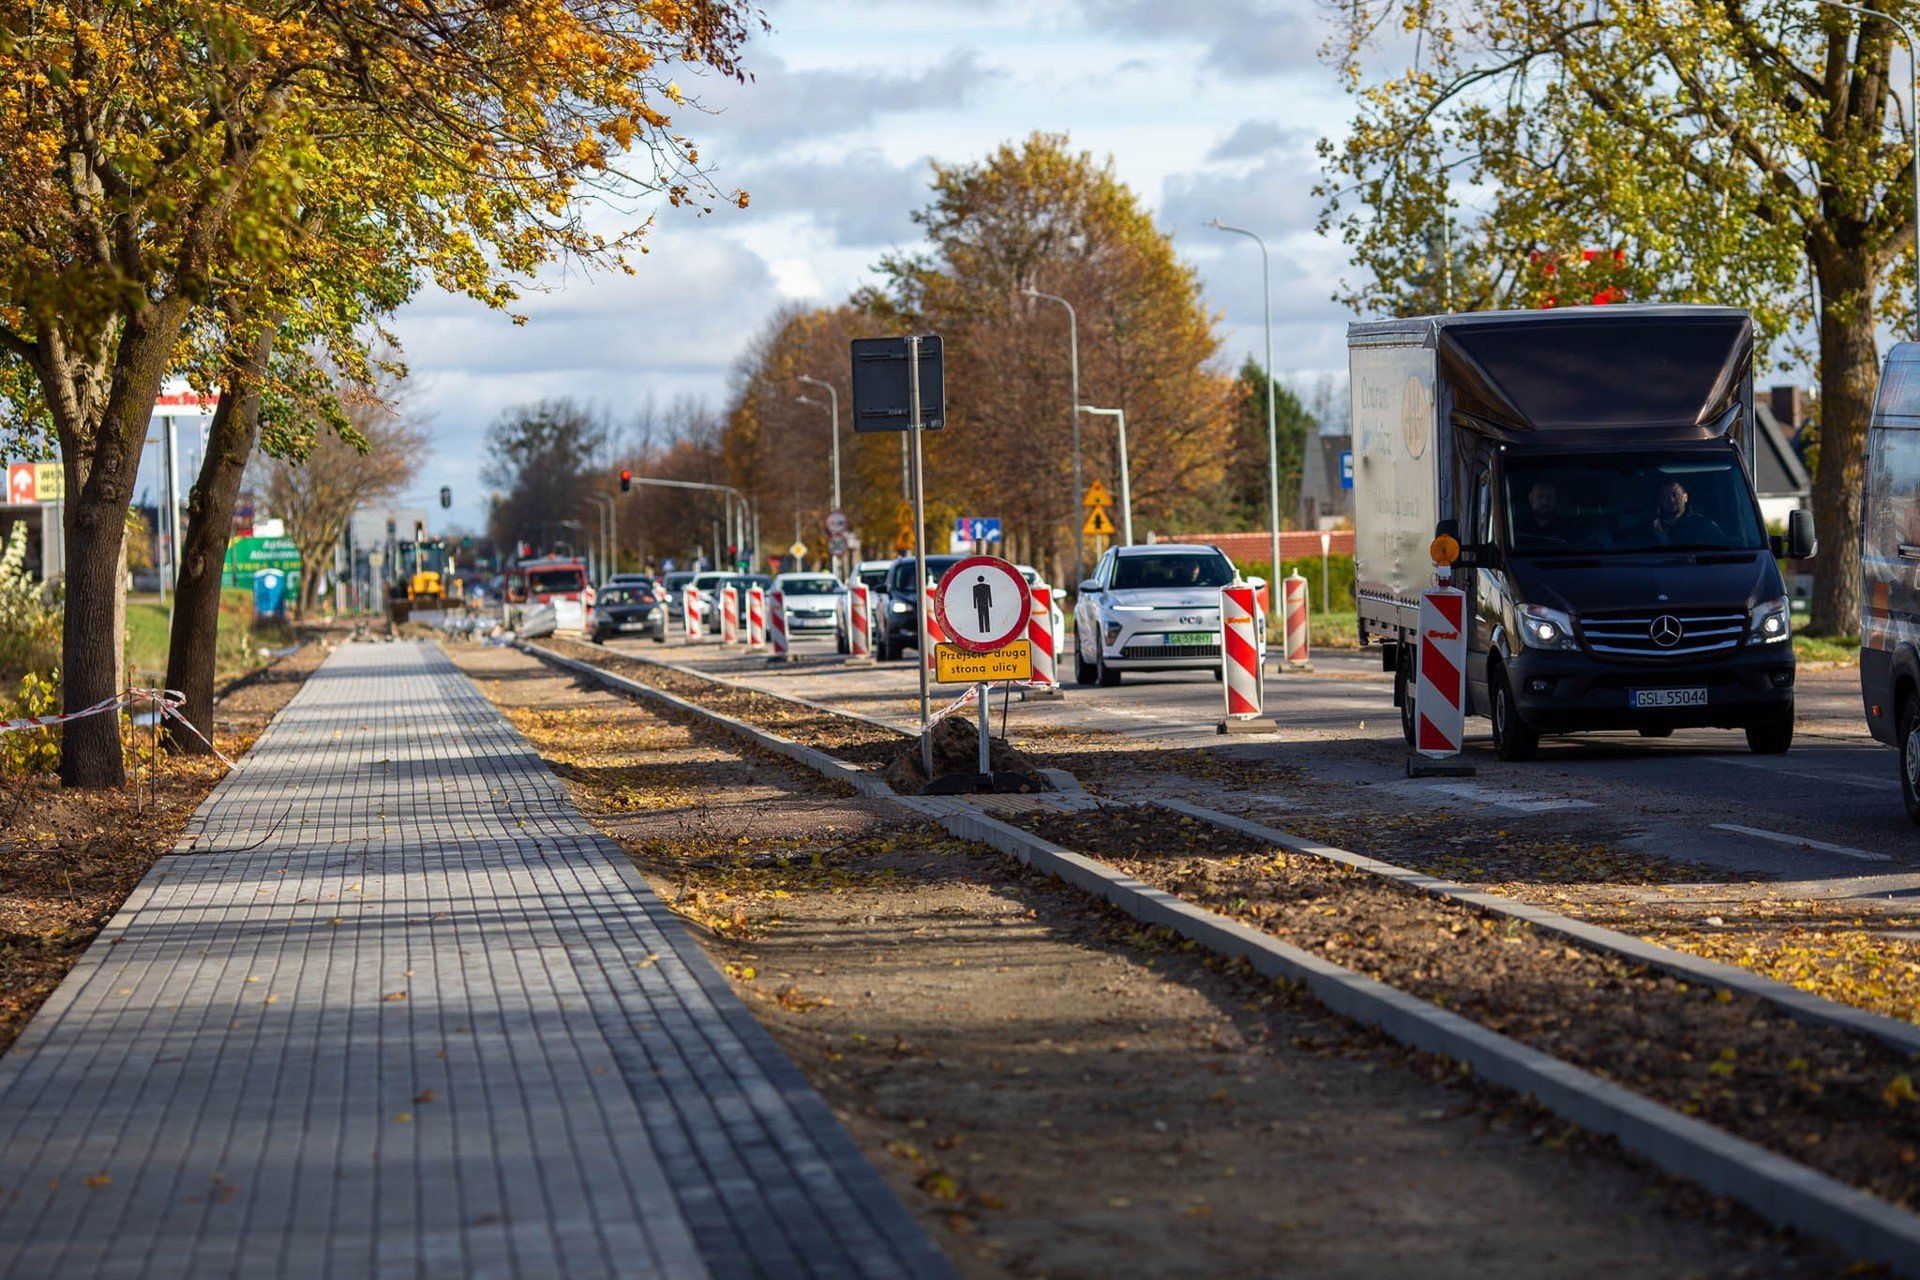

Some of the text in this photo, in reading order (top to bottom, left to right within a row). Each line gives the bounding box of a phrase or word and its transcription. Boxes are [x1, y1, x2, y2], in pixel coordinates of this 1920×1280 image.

[951, 662, 1018, 674] stroną ulicy
[1638, 690, 1706, 705] GSL 55044
